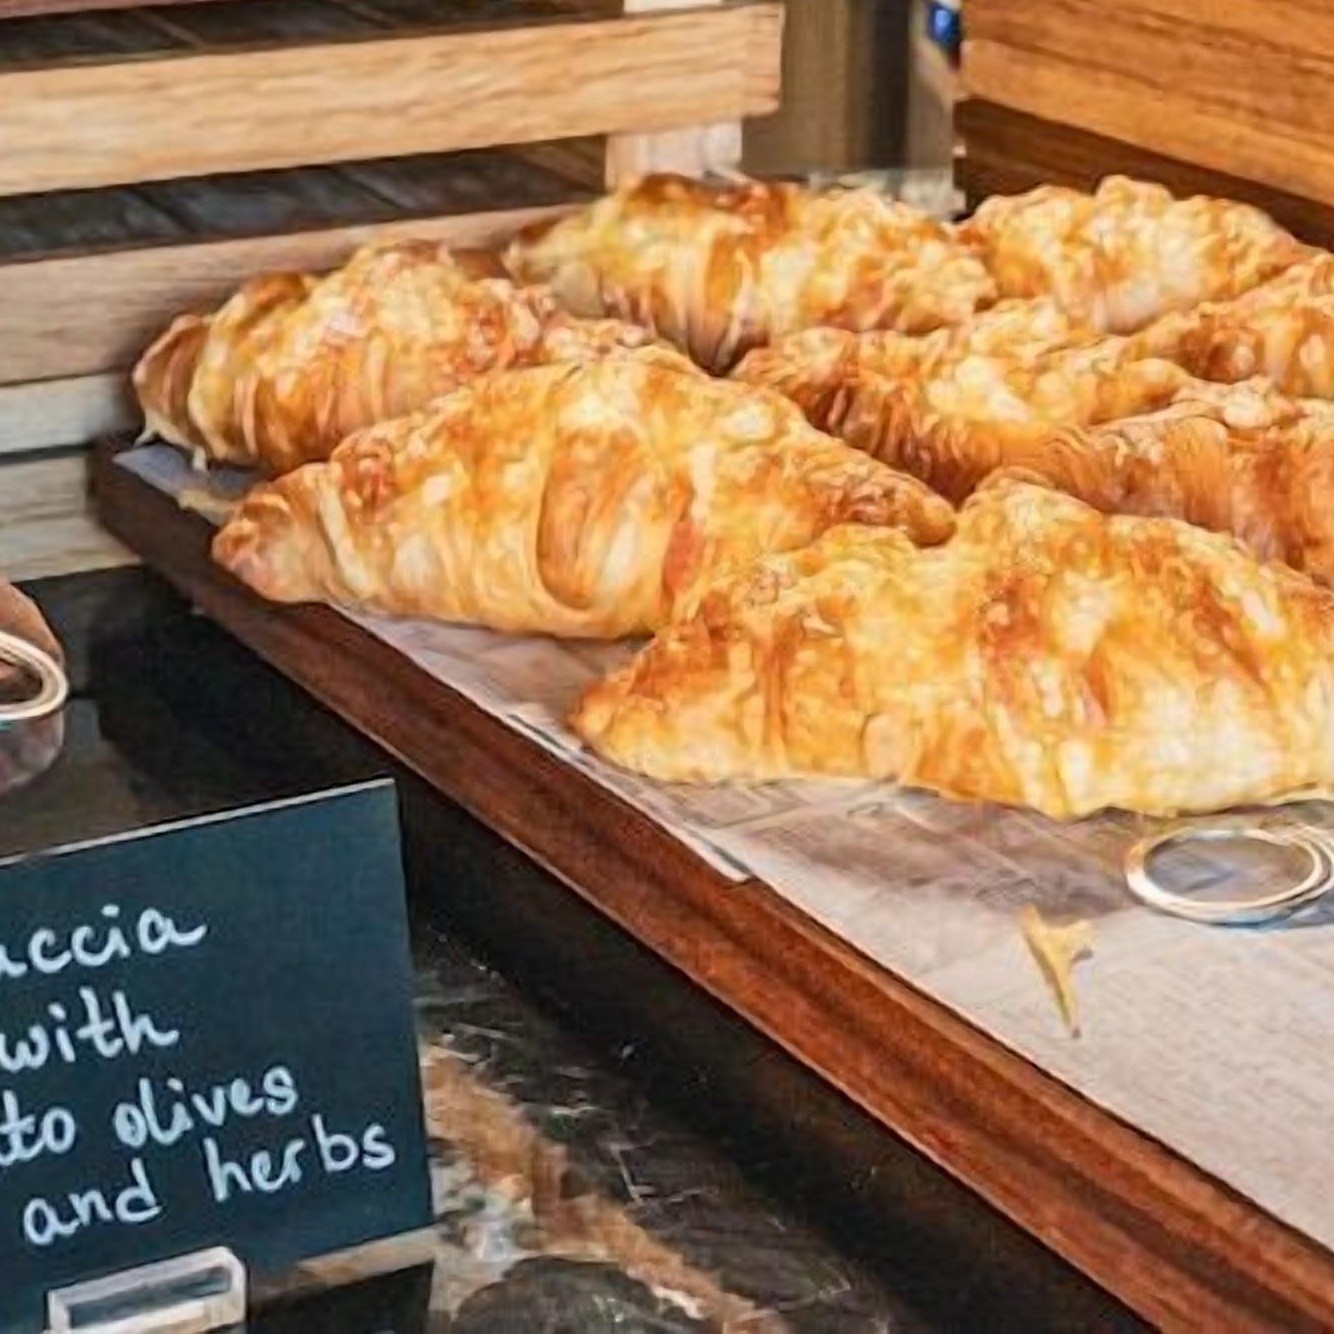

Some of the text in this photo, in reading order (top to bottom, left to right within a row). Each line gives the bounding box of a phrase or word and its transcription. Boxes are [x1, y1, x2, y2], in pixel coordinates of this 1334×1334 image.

[113, 1066, 299, 1149] olives
[22, 1114, 397, 1246] and herbs
